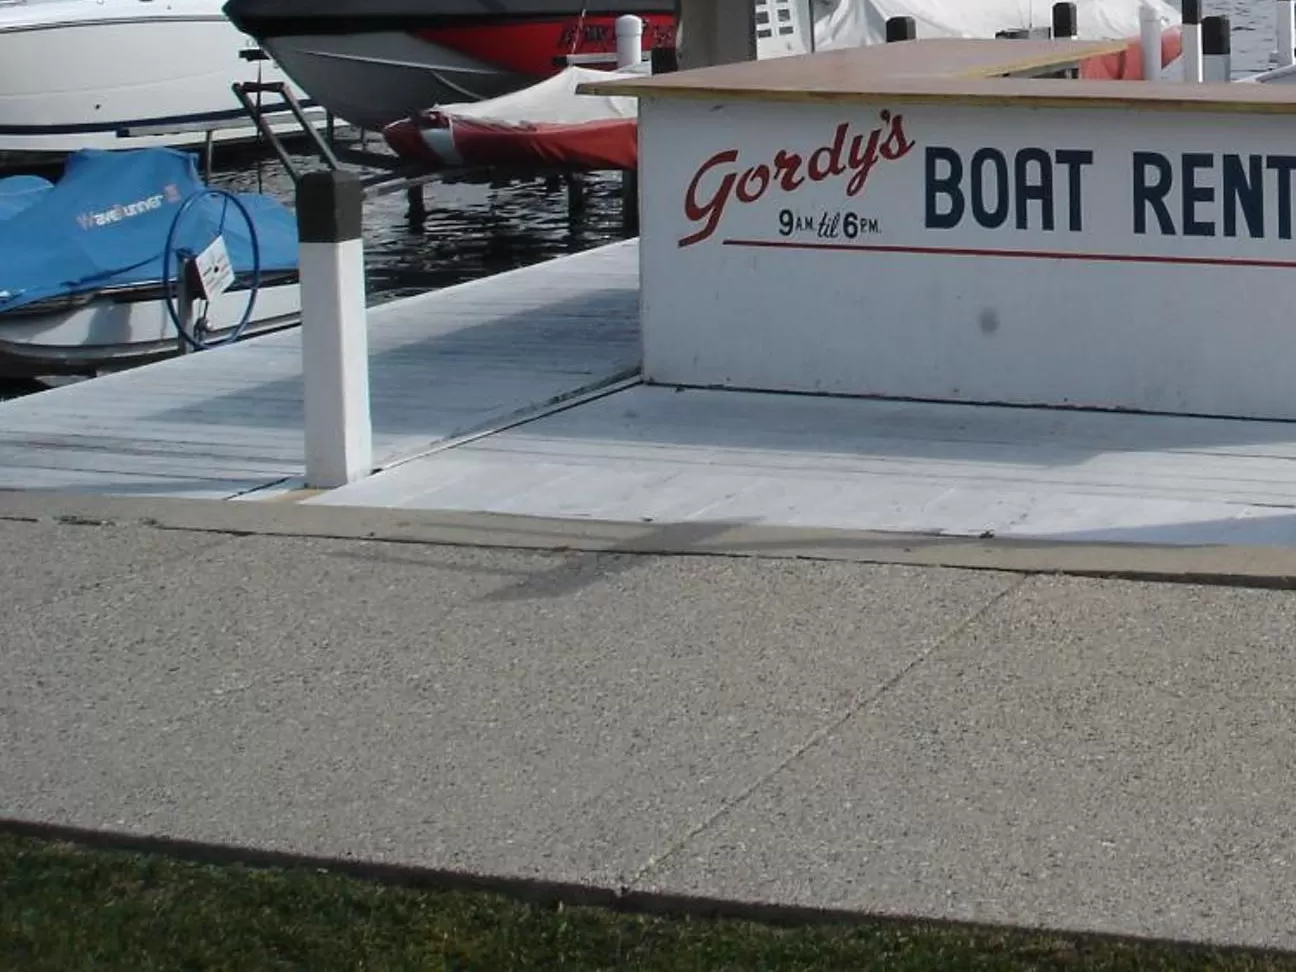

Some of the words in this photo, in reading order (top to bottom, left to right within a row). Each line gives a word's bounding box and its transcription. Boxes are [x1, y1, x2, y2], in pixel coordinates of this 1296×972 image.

[678, 109, 916, 247] Gordy's
[925, 147, 1093, 231] BOAT
[76, 194, 164, 230] WaveRunner
[817, 212, 840, 238] til
